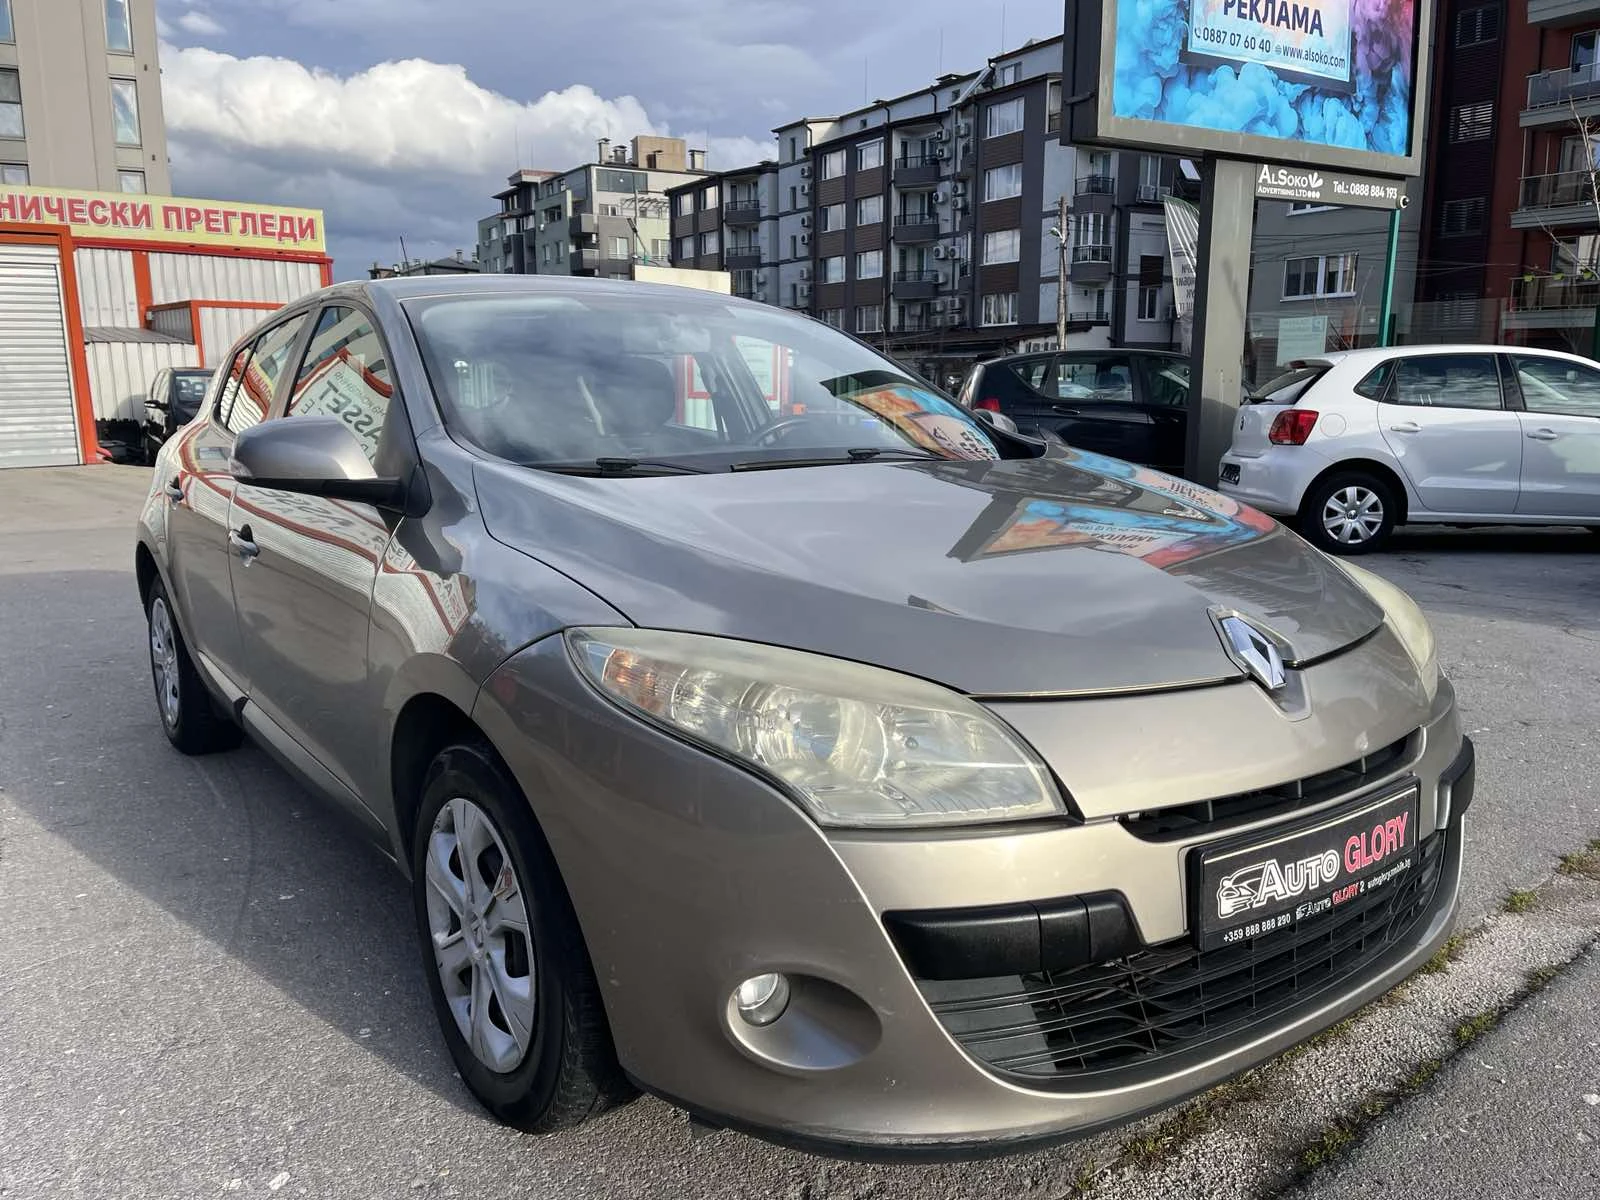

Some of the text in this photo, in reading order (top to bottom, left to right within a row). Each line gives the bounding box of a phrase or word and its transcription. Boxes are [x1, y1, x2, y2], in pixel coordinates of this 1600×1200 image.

[1223, 0, 1323, 37] РЕКЛАМА
[1203, 27, 1345, 69] 0887 07 60 40 www.alsoko.com
[1350, 182, 1369, 196] 0888
[1370, 184, 1385, 199] 884
[1386, 186, 1397, 200] 193
[0, 194, 317, 243] НИЧЕСКИ ПРЕГЛЕДИ
[1253, 811, 1408, 908] AUTO GLORY
[1223, 928, 1243, 942] +359
[1245, 923, 1260, 937] 888
[1261, 919, 1276, 932] 888
[1332, 881, 1359, 905] GLORY
[1359, 880, 1365, 893] 2
